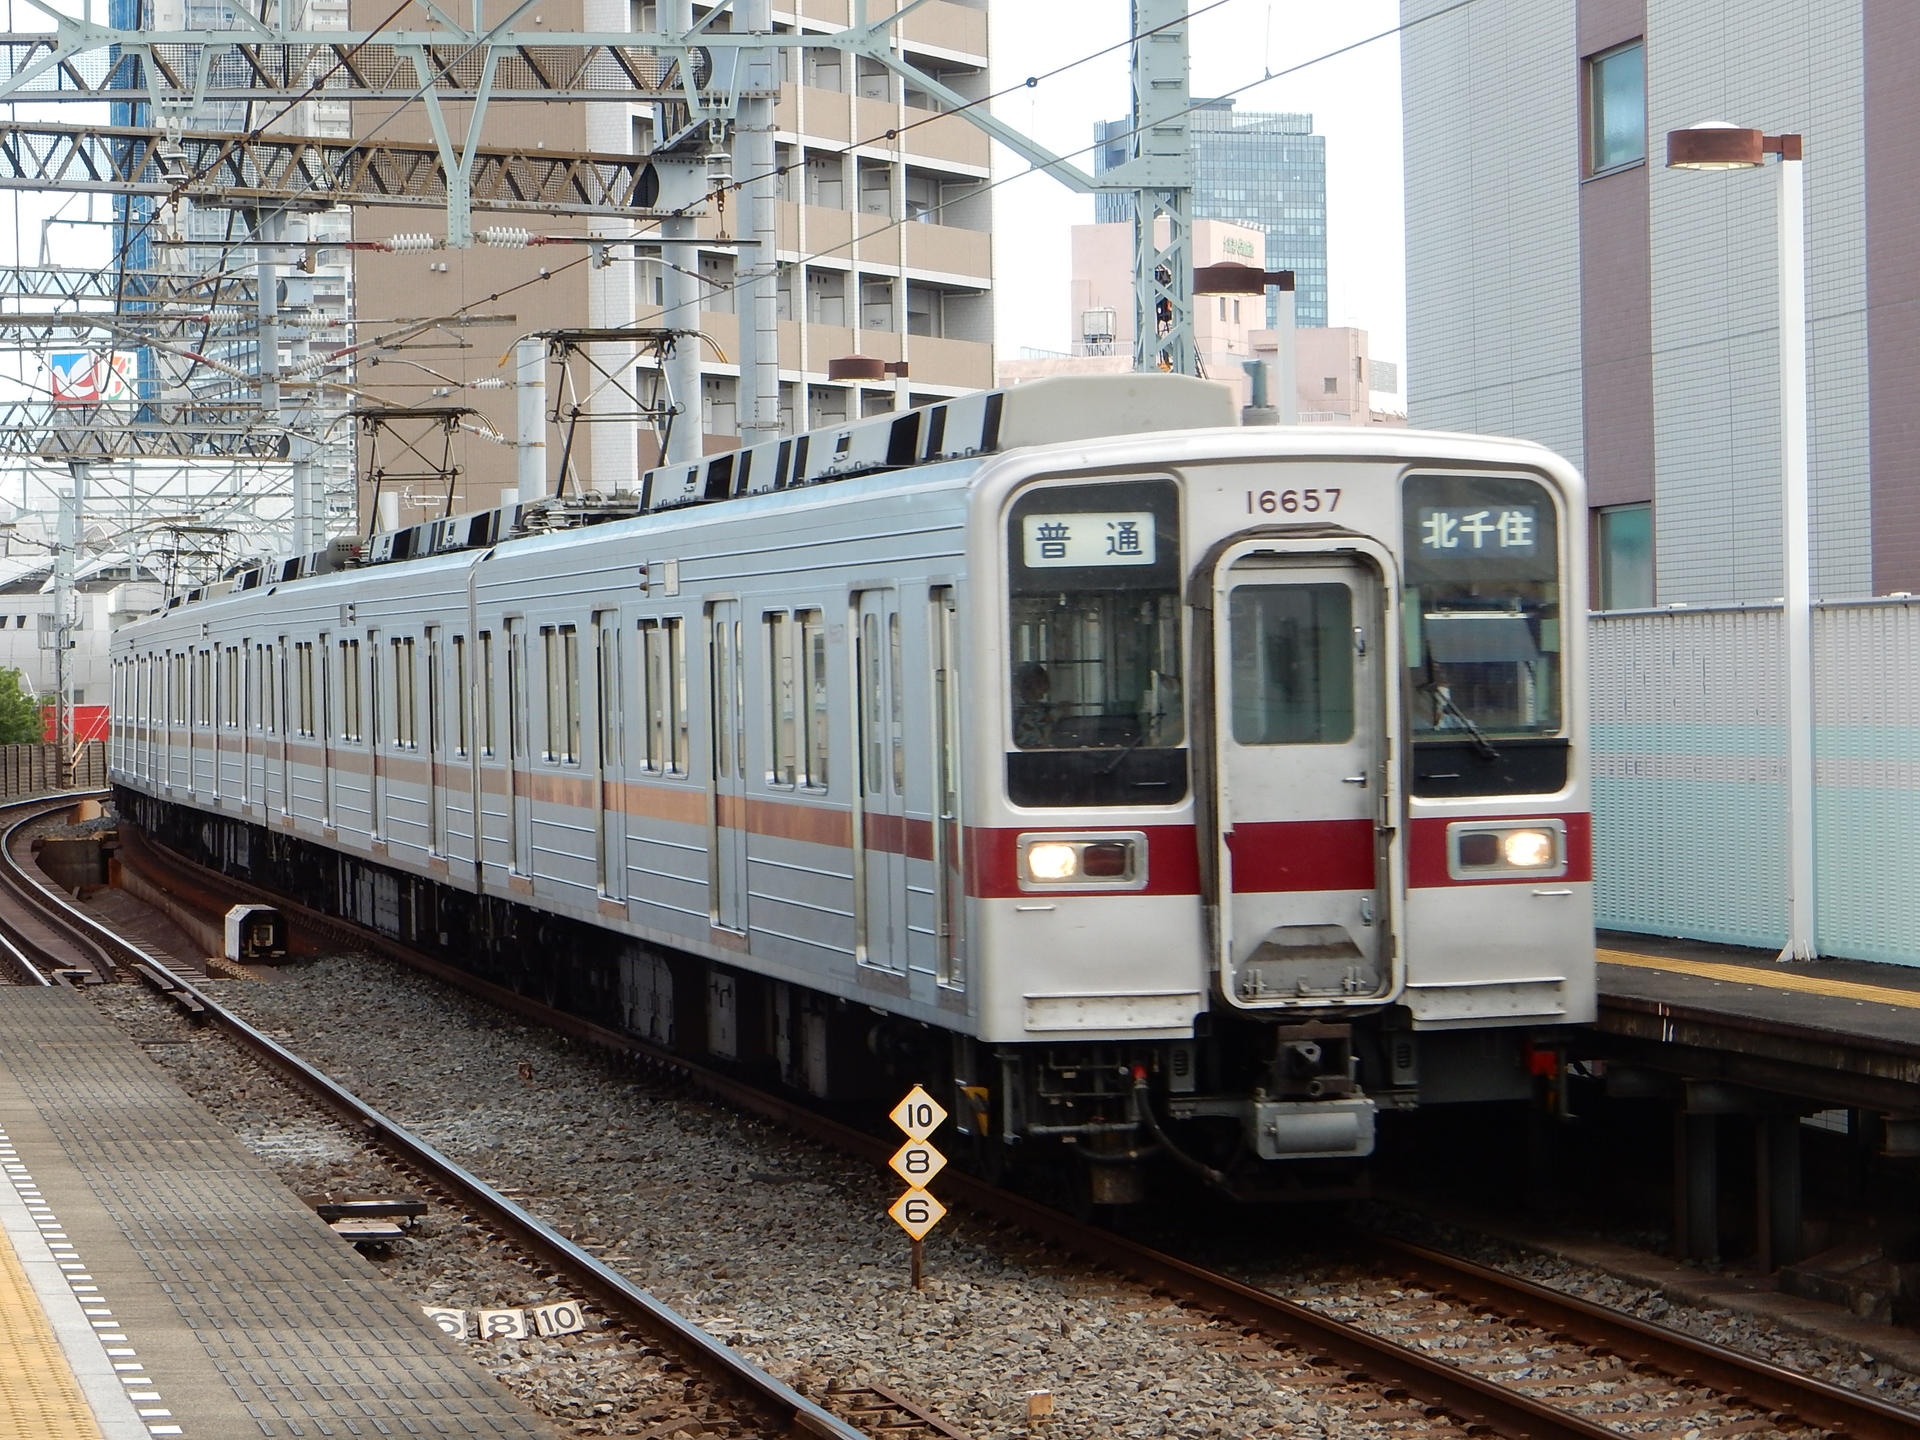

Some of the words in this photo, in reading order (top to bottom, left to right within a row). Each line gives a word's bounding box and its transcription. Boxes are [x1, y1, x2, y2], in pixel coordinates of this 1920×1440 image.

[1247, 488, 1342, 514] 16657
[1035, 522, 1143, 558] 普通
[1422, 510, 1533, 549] 北千住
[907, 1103, 933, 1128] 10
[905, 1149, 930, 1174] 8
[905, 1199, 930, 1223] 6
[430, 1312, 462, 1335] 6
[487, 1314, 519, 1335] 8
[540, 1306, 576, 1333] 10
